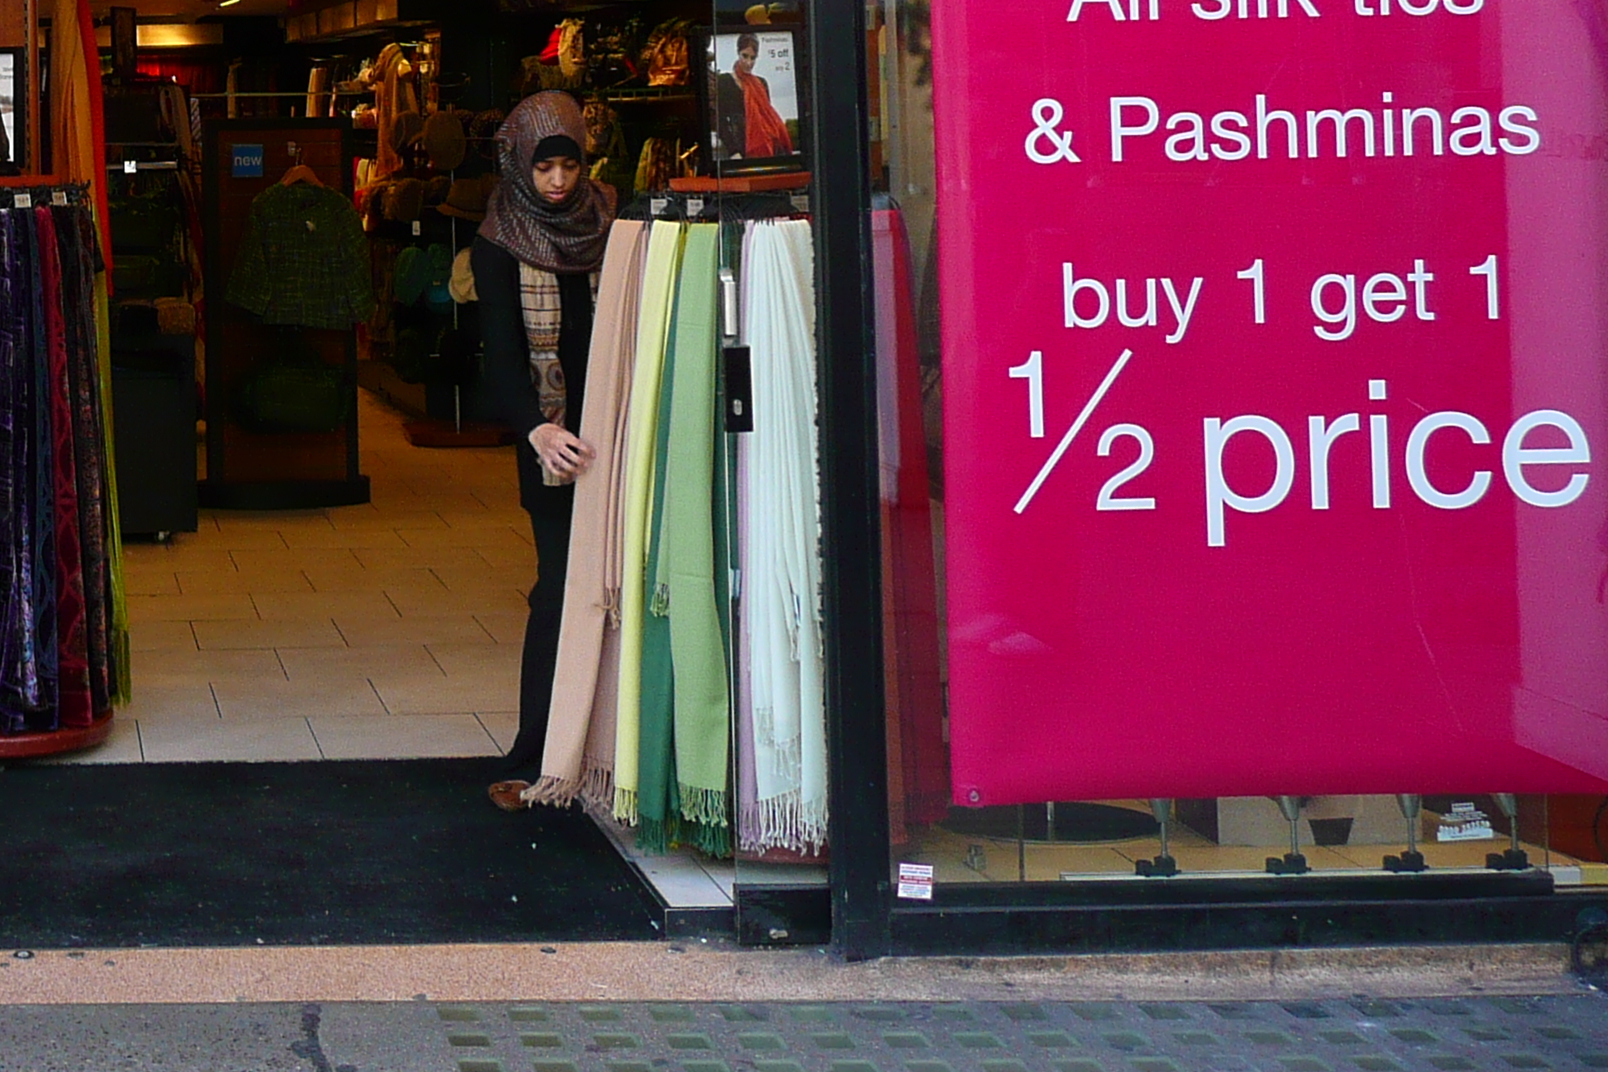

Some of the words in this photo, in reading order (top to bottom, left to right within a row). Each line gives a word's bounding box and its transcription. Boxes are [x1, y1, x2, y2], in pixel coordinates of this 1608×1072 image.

[234, 155, 262, 167] new
[1024, 98, 1082, 165] &
[1109, 92, 1541, 166] Pashminas
[1062, 262, 1203, 344] buy
[1236, 258, 1266, 324] 1
[1310, 259, 1436, 341] get
[1468, 254, 1501, 320] 1
[1203, 379, 1593, 547] price
